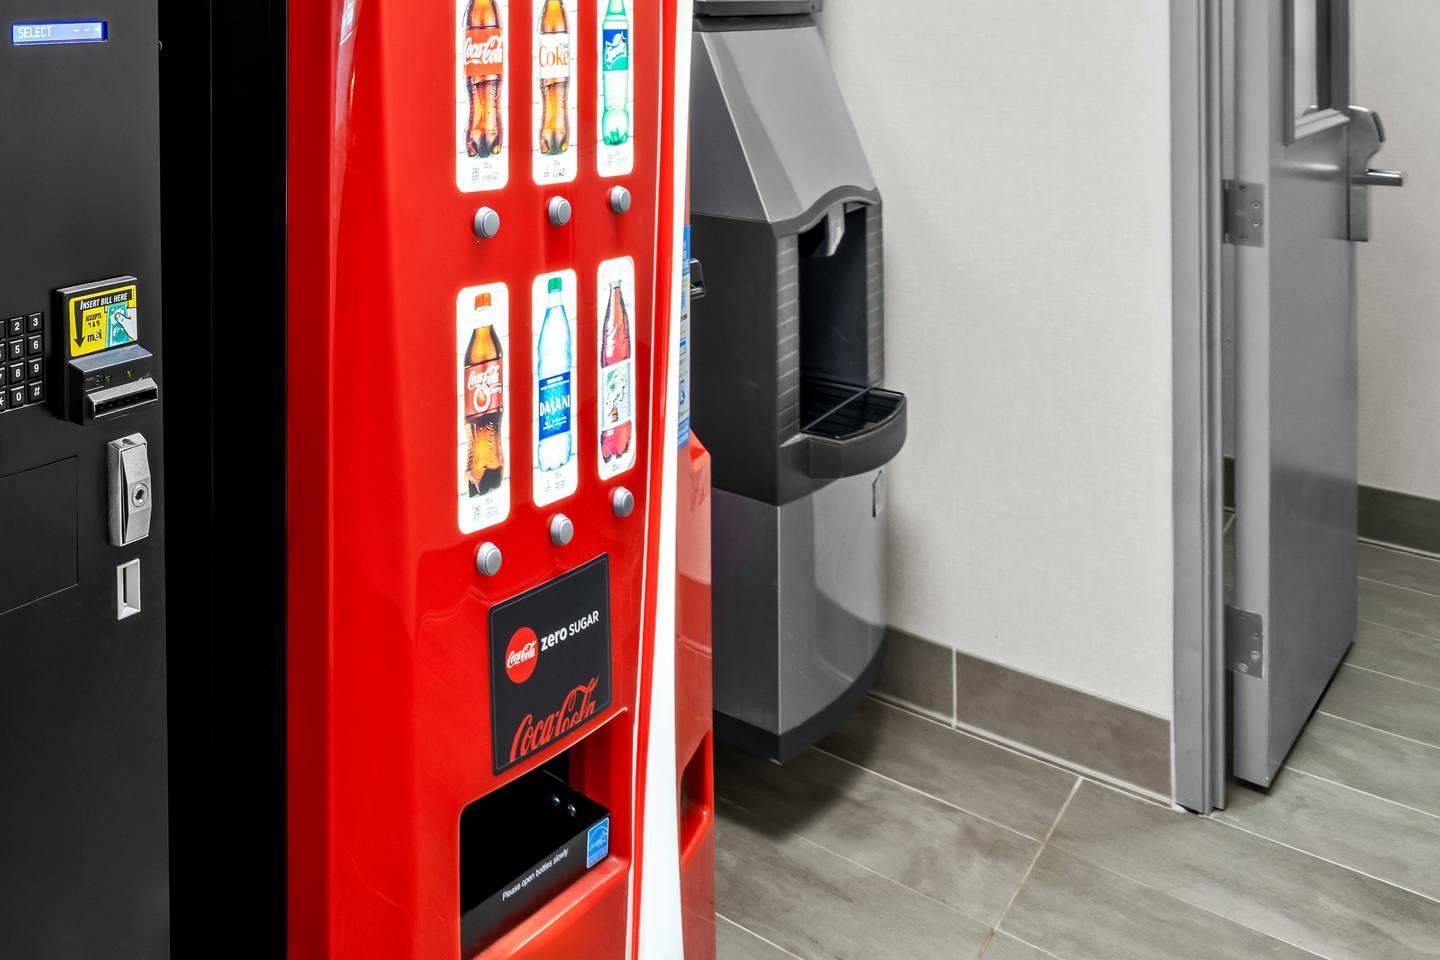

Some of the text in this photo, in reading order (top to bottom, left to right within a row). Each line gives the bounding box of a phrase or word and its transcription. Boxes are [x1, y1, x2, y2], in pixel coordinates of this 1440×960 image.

[17, 26, 53, 39] SELECT
[538, 44, 569, 67] Coke
[79, 292, 128, 311] INSERT BILL HERE
[14, 322, 20, 331] 2
[33, 318, 39, 327] 3
[85, 312, 102, 322] ACCEPTS
[87, 329, 102, 343] mei
[15, 345, 21, 354] 5
[33, 340, 39, 349] 6
[15, 369, 21, 378] 8
[33, 364, 39, 373] 9
[16, 392, 22, 402] 0
[539, 395, 571, 417] DASANI
[540, 610, 600, 652] zero SUGAR
[506, 640, 537, 669] Coca-Cola
[509, 674, 600, 763] Coca-Cola
[501, 847, 569, 902] Please open bottles slowly
